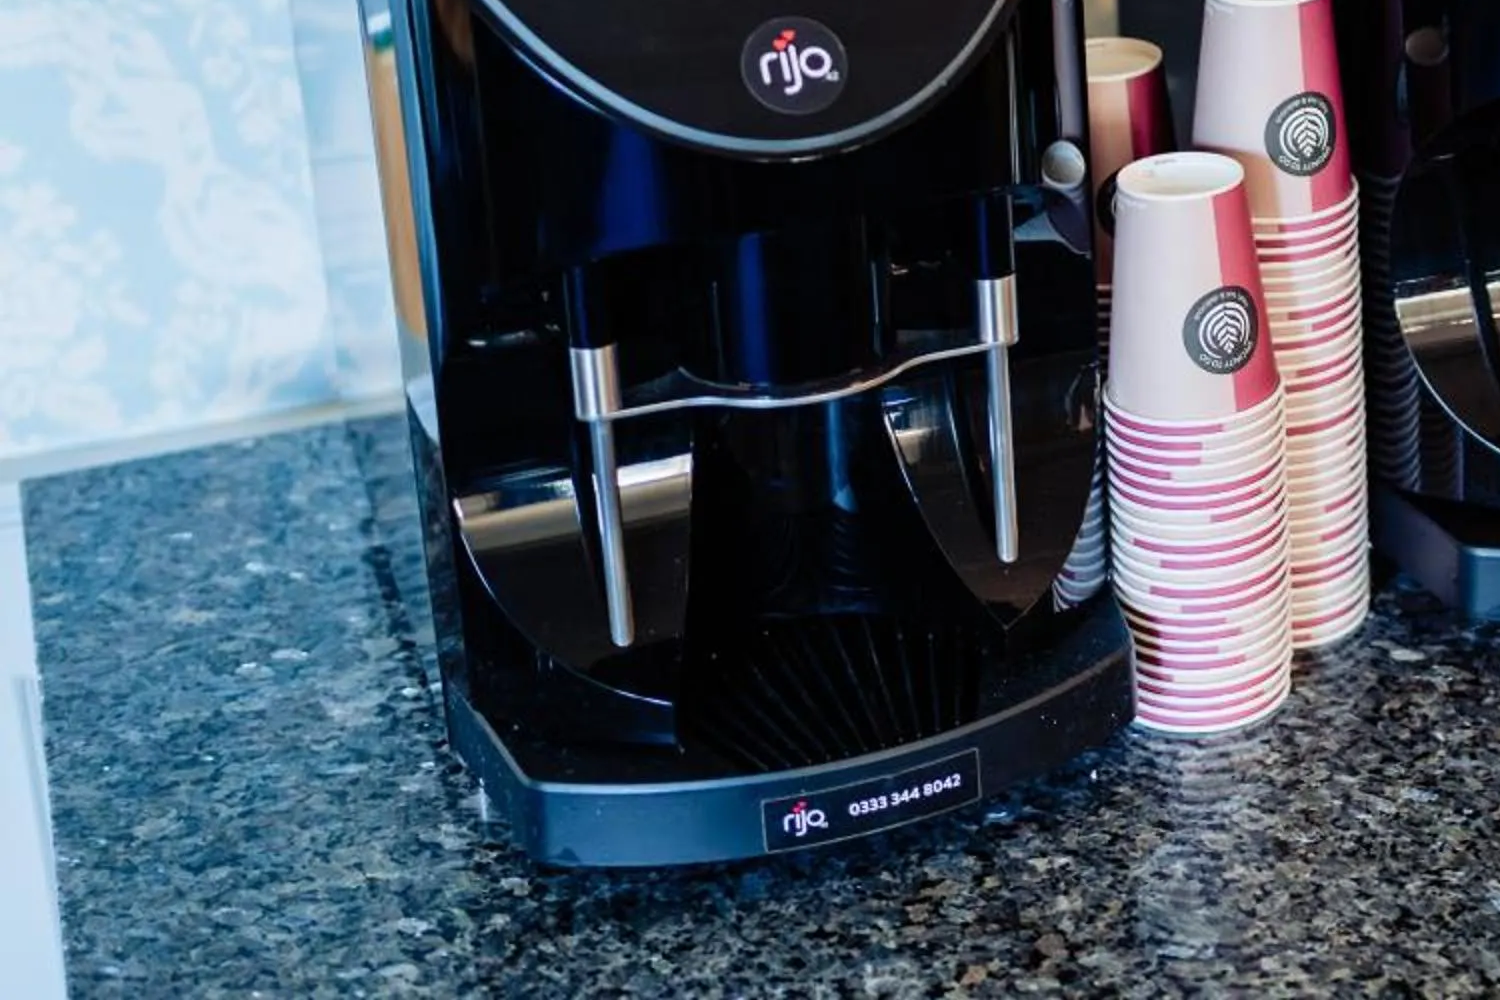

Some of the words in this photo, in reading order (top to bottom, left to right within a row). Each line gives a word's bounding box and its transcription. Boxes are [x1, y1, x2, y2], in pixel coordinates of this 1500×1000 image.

[759, 28, 833, 96] rijo
[783, 798, 825, 837] rijo
[848, 796, 887, 817] 0333
[891, 786, 921, 807] 344
[923, 773, 962, 797] 8042
